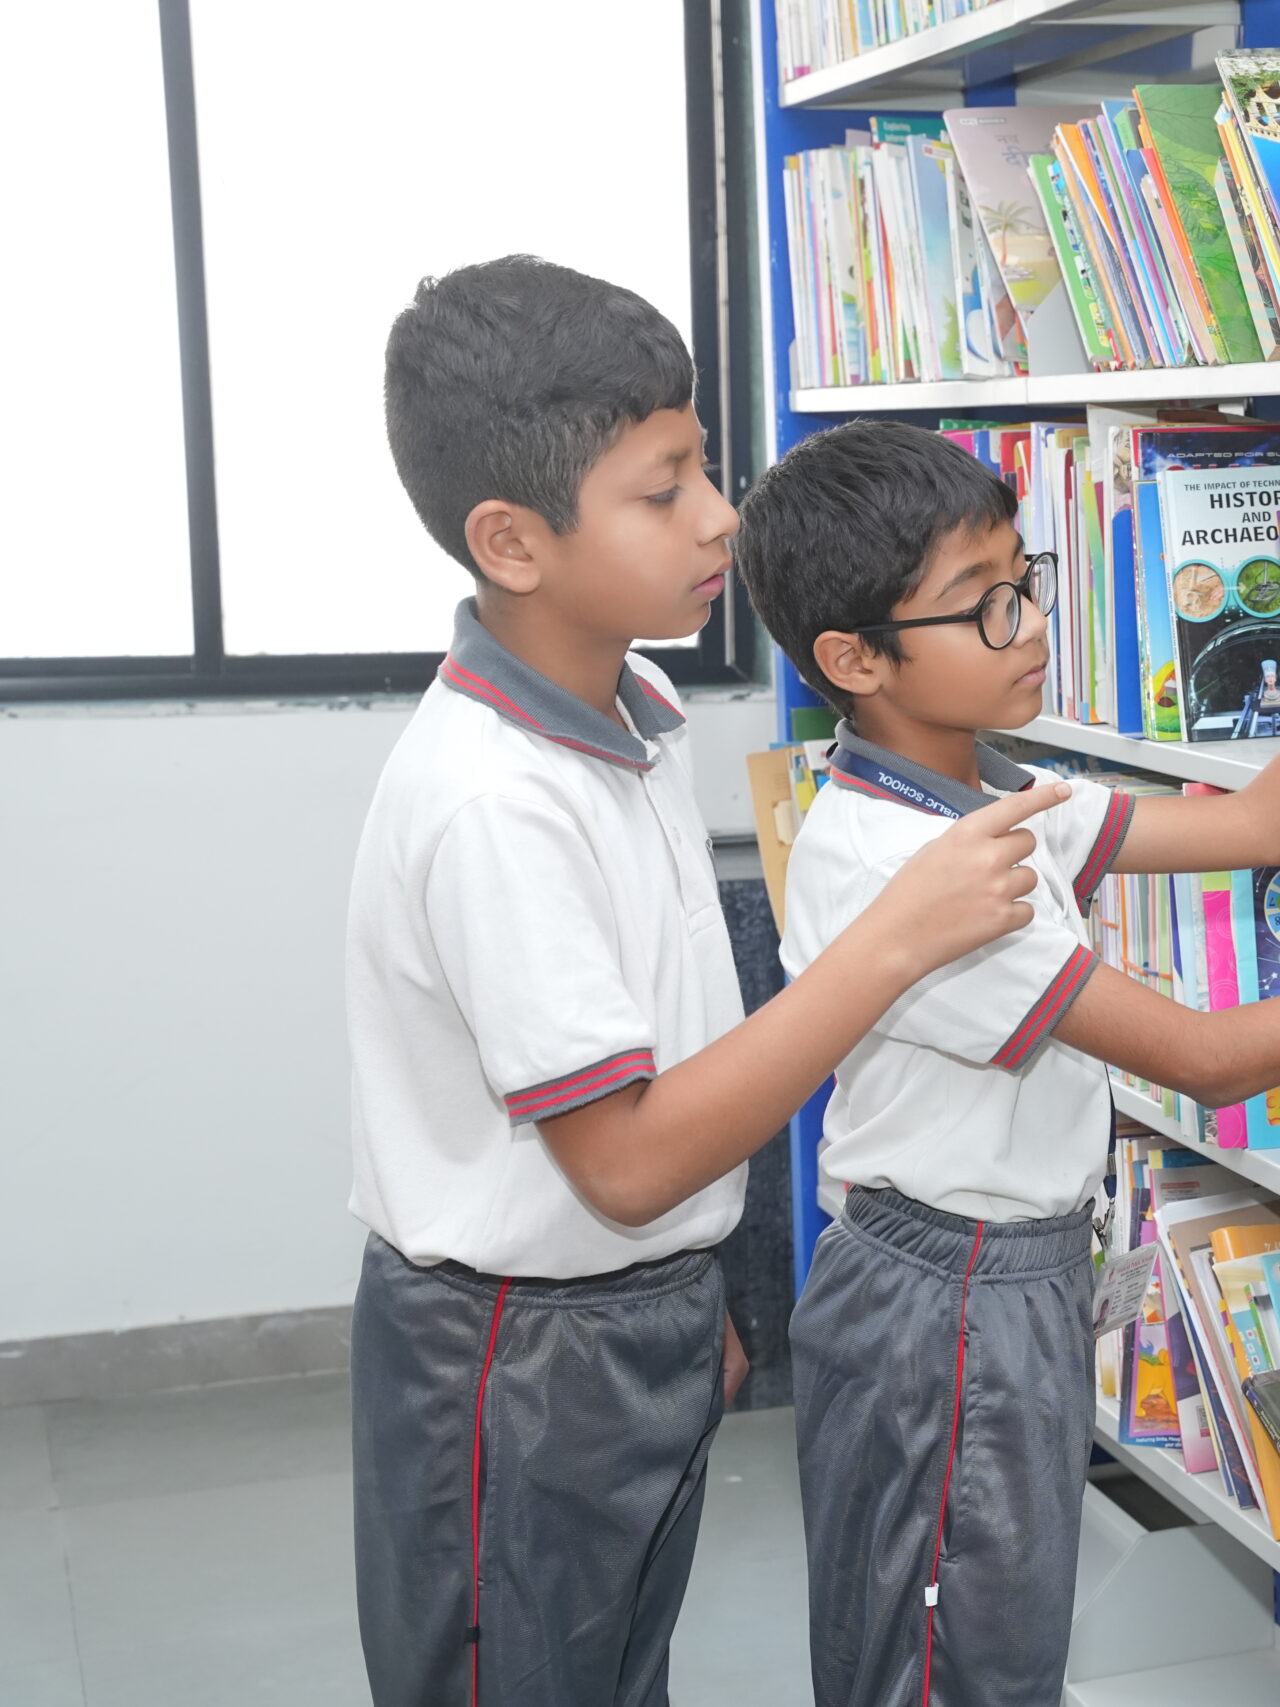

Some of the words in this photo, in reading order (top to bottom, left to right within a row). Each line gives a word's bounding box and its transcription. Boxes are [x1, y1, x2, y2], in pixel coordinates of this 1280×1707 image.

[1167, 451, 1233, 459] ADAPTED
[1184, 483, 1201, 492] THE
[1204, 481, 1237, 491] IMPACT
[1239, 481, 1251, 489] OF
[1241, 510, 1272, 524] AND
[1181, 524, 1278, 547] ARCHAEO
[878, 771, 923, 803] SCHOOL
[925, 796, 960, 822] UBLIC
